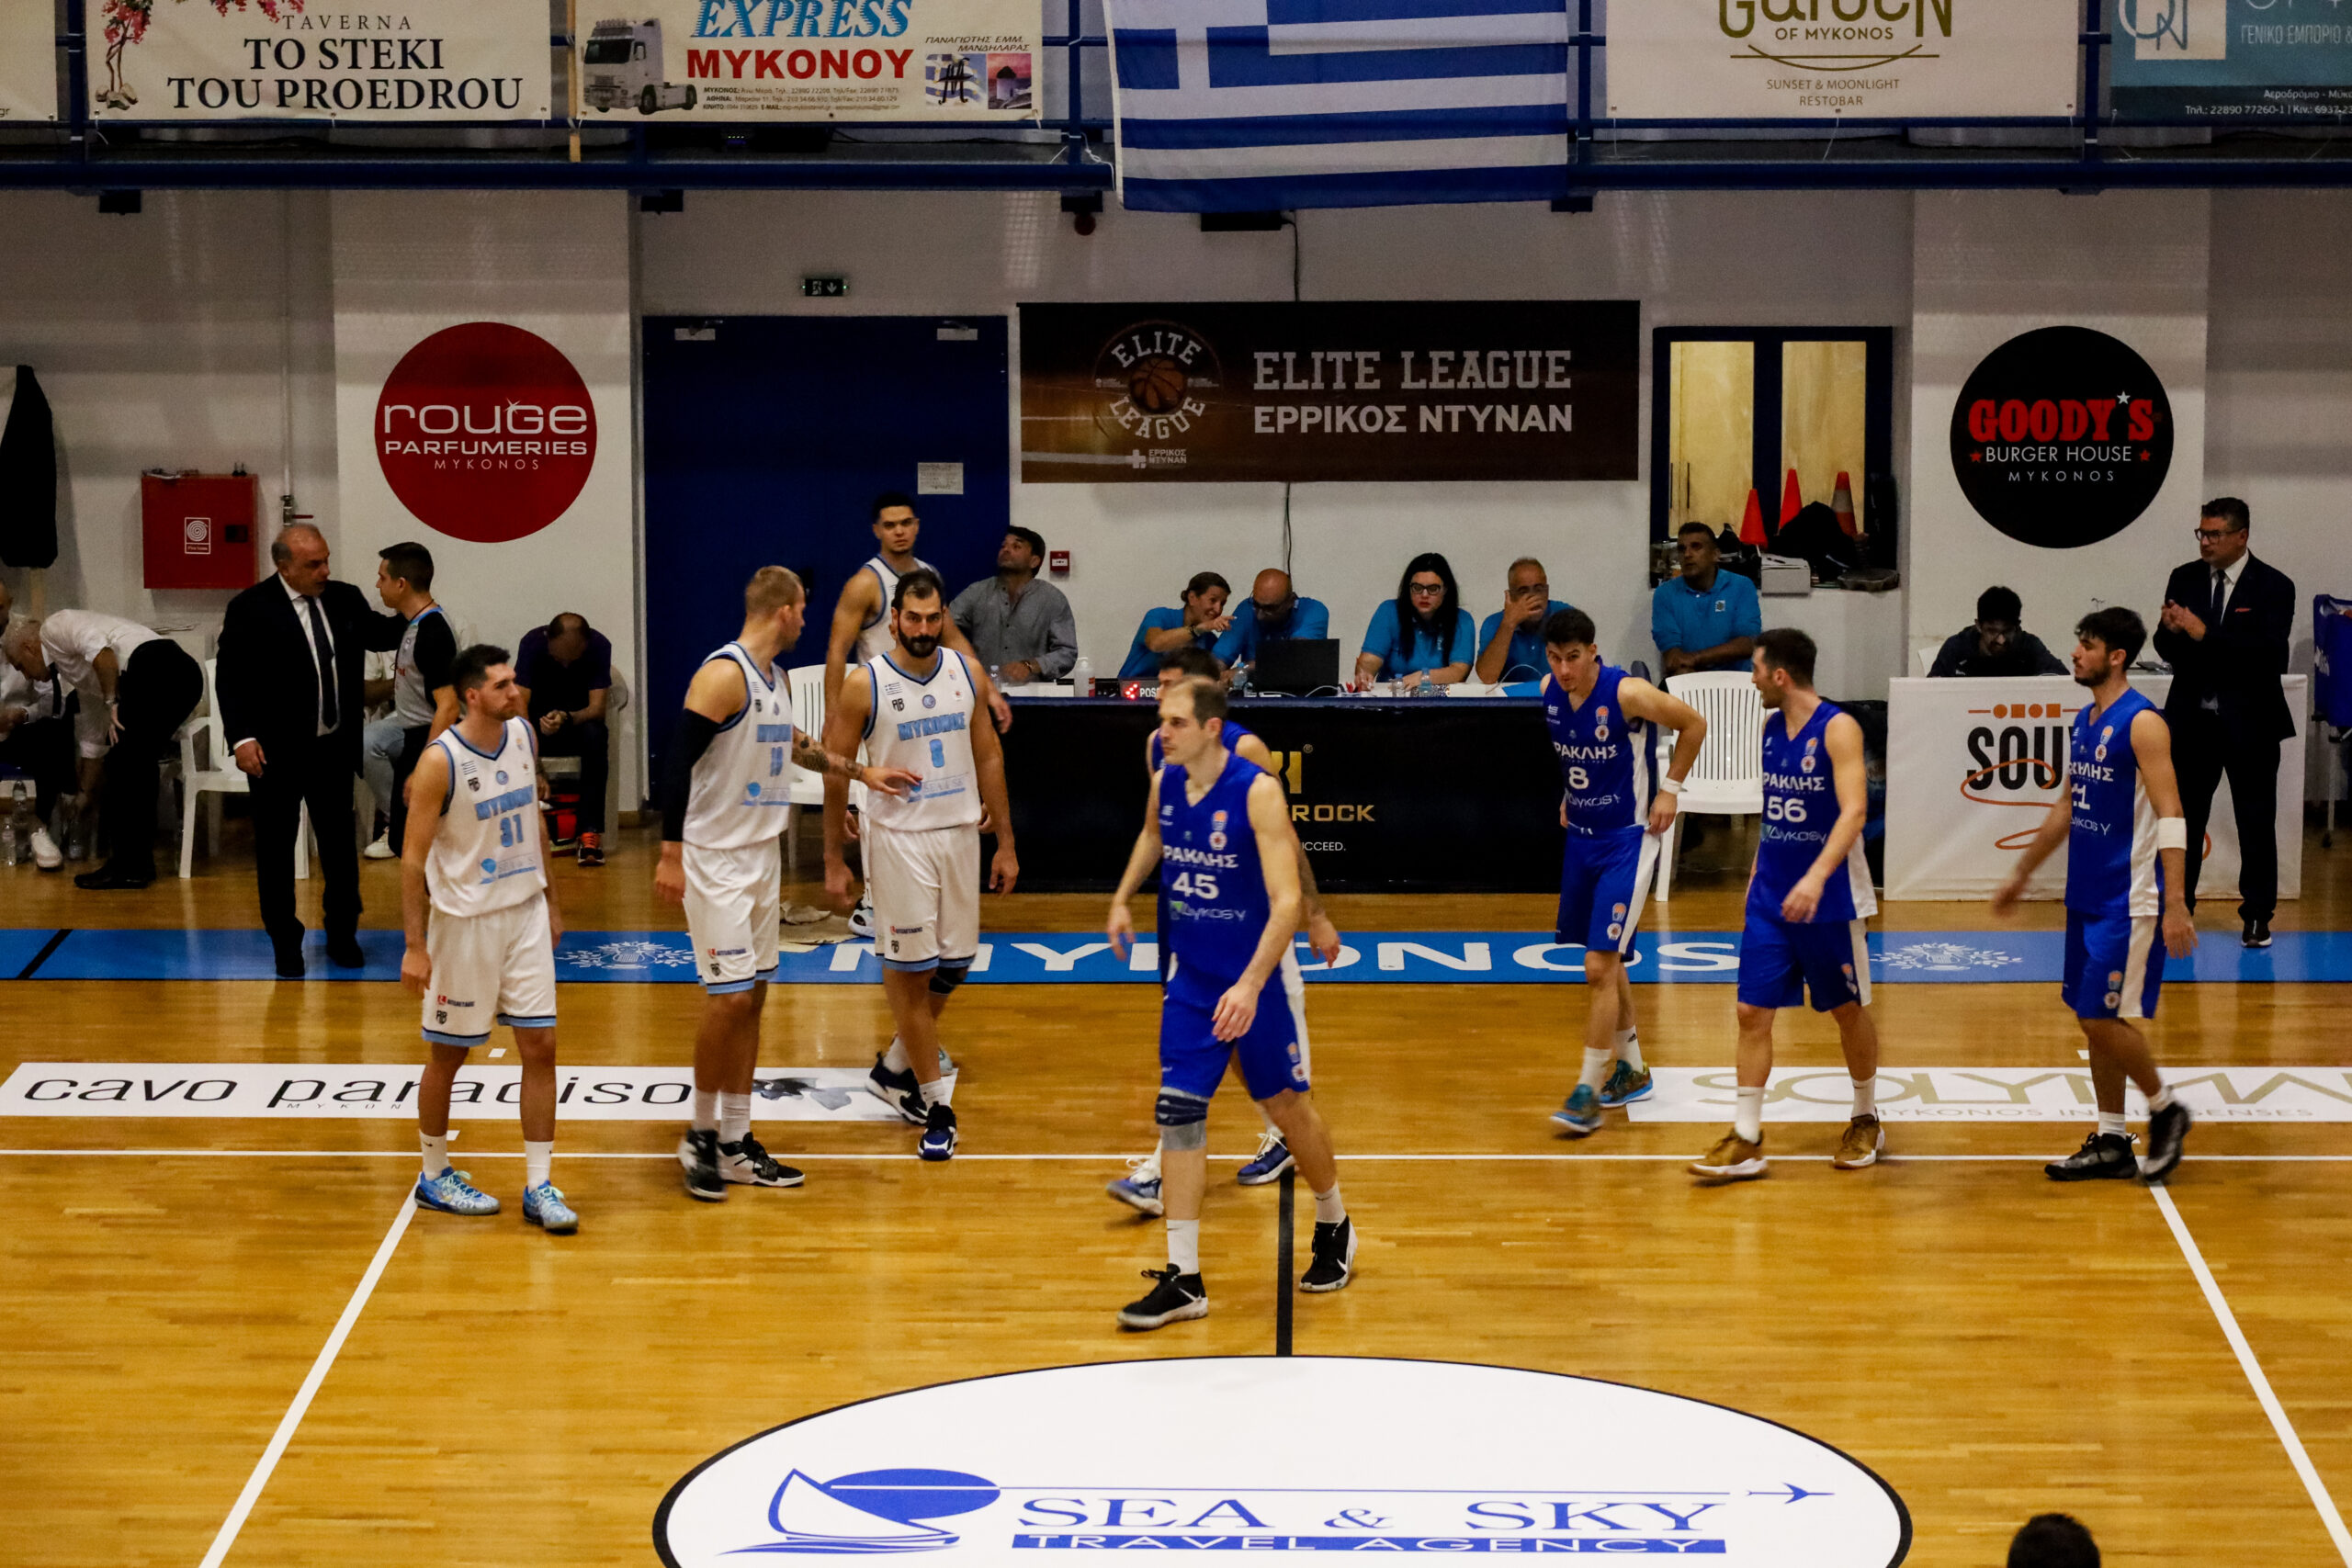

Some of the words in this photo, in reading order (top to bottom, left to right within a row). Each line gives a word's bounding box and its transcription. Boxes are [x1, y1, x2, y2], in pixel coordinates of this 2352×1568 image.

[283, 15, 412, 30] TAVERNA
[690, 0, 912, 38] EXPRESS
[1775, 28, 1798, 39] OF
[1805, 28, 1894, 40] MYKONOS
[2242, 24, 2283, 44] ΓΕΝΙΚΟ
[2288, 24, 2341, 44] ΕΜΠΟΡΙΟ
[243, 38, 305, 70] TO
[319, 38, 445, 70] STEKI
[167, 77, 263, 108] TOU
[275, 77, 523, 109] PROEDROU
[1767, 79, 1812, 90] SUNSET
[1815, 79, 1824, 90] &
[1827, 79, 1900, 89] MOONLIGHT
[1799, 96, 1863, 107] RESTOBAR
[2211, 106, 2242, 115] 22890
[2245, 106, 2285, 115] 77260-1
[1112, 332, 1202, 367] ELITE
[1254, 351, 1380, 390] ELITE
[1400, 350, 1571, 389] LEAGUE
[1110, 396, 1205, 439] LEAGUE
[1254, 405, 1407, 434] ΕΡΡΙΚΟΣ
[1419, 404, 1572, 433] ΝΤΥΝΑΝ
[385, 441, 587, 455] PARFUMERIES
[1985, 446, 2058, 462] BURGER
[2066, 446, 2132, 462] HOUSE
[435, 459, 538, 470] MYKONOS
[2008, 470, 2114, 481] MYKONOS
[1140, 687, 1159, 697] POS
[1553, 741, 1619, 760] ΡΑΚΛΗΣ
[1966, 726, 2075, 791] SOU
[1569, 766, 1589, 790] 8
[1762, 772, 1826, 792] ΡΑΚΛΗΣ
[1290, 805, 1375, 821] ROCK
[1767, 795, 1807, 823] 56
[1163, 844, 1238, 868] ΡΑΚΛΗΣ
[1171, 872, 1219, 899] 45
[24, 1078, 237, 1101] cavo
[1017, 1497, 1276, 1529] SEA
[1323, 1507, 1395, 1529] &
[1465, 1500, 1725, 1531] SKY
[1028, 1535, 1316, 1551] TRAVEL
[1353, 1537, 1700, 1553] AGENCY
